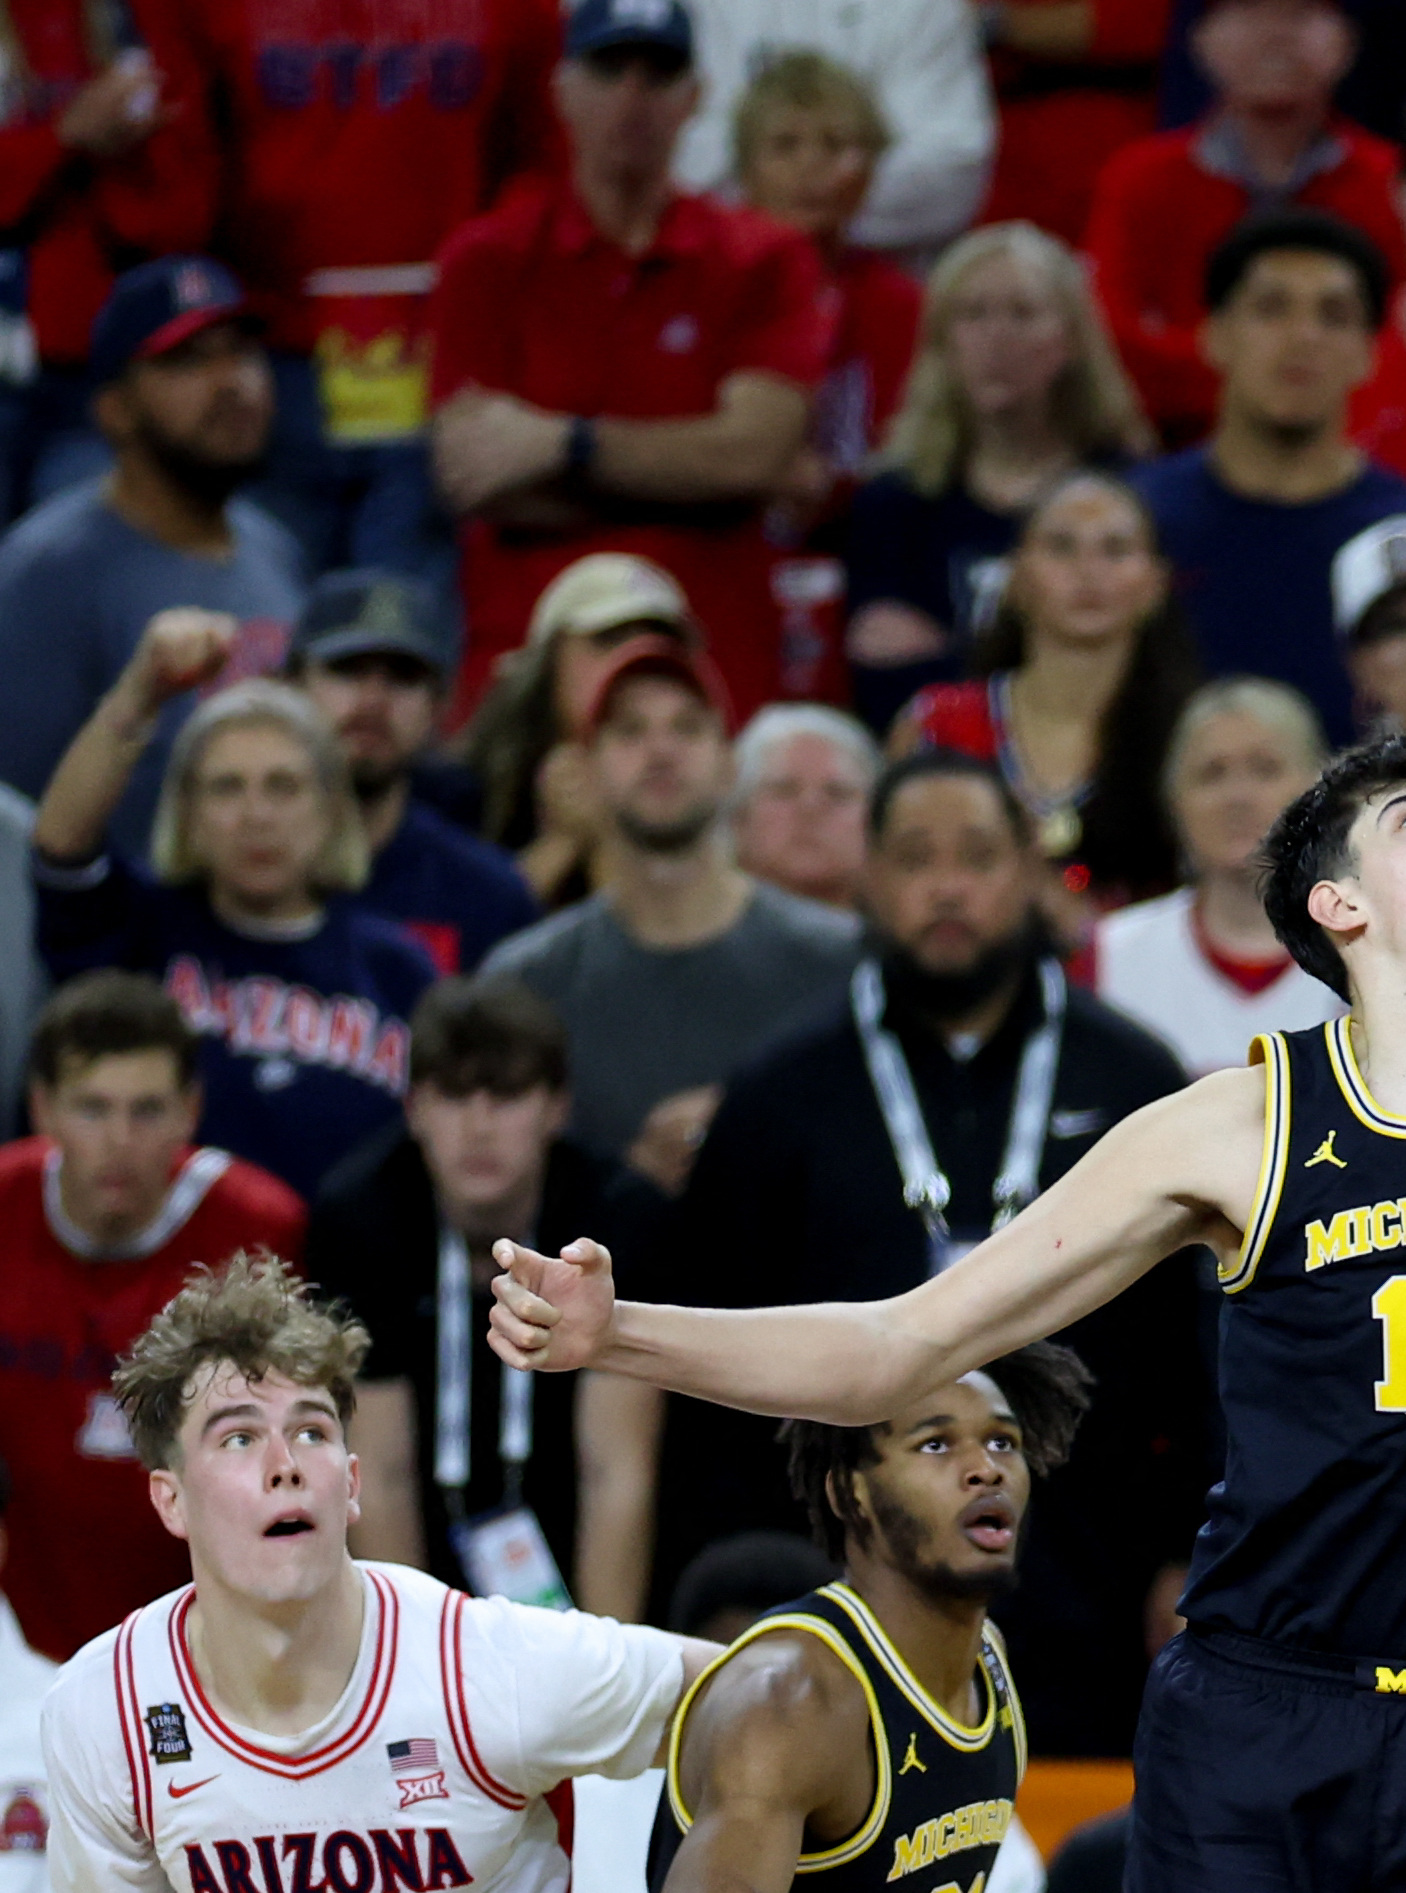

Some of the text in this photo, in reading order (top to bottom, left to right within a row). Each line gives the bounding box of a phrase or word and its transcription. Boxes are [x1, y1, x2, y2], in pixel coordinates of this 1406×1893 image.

[150, 1713, 182, 1729] FINAL
[156, 1738, 187, 1753] FOUR
[184, 1827, 475, 1893] ARIZONA
